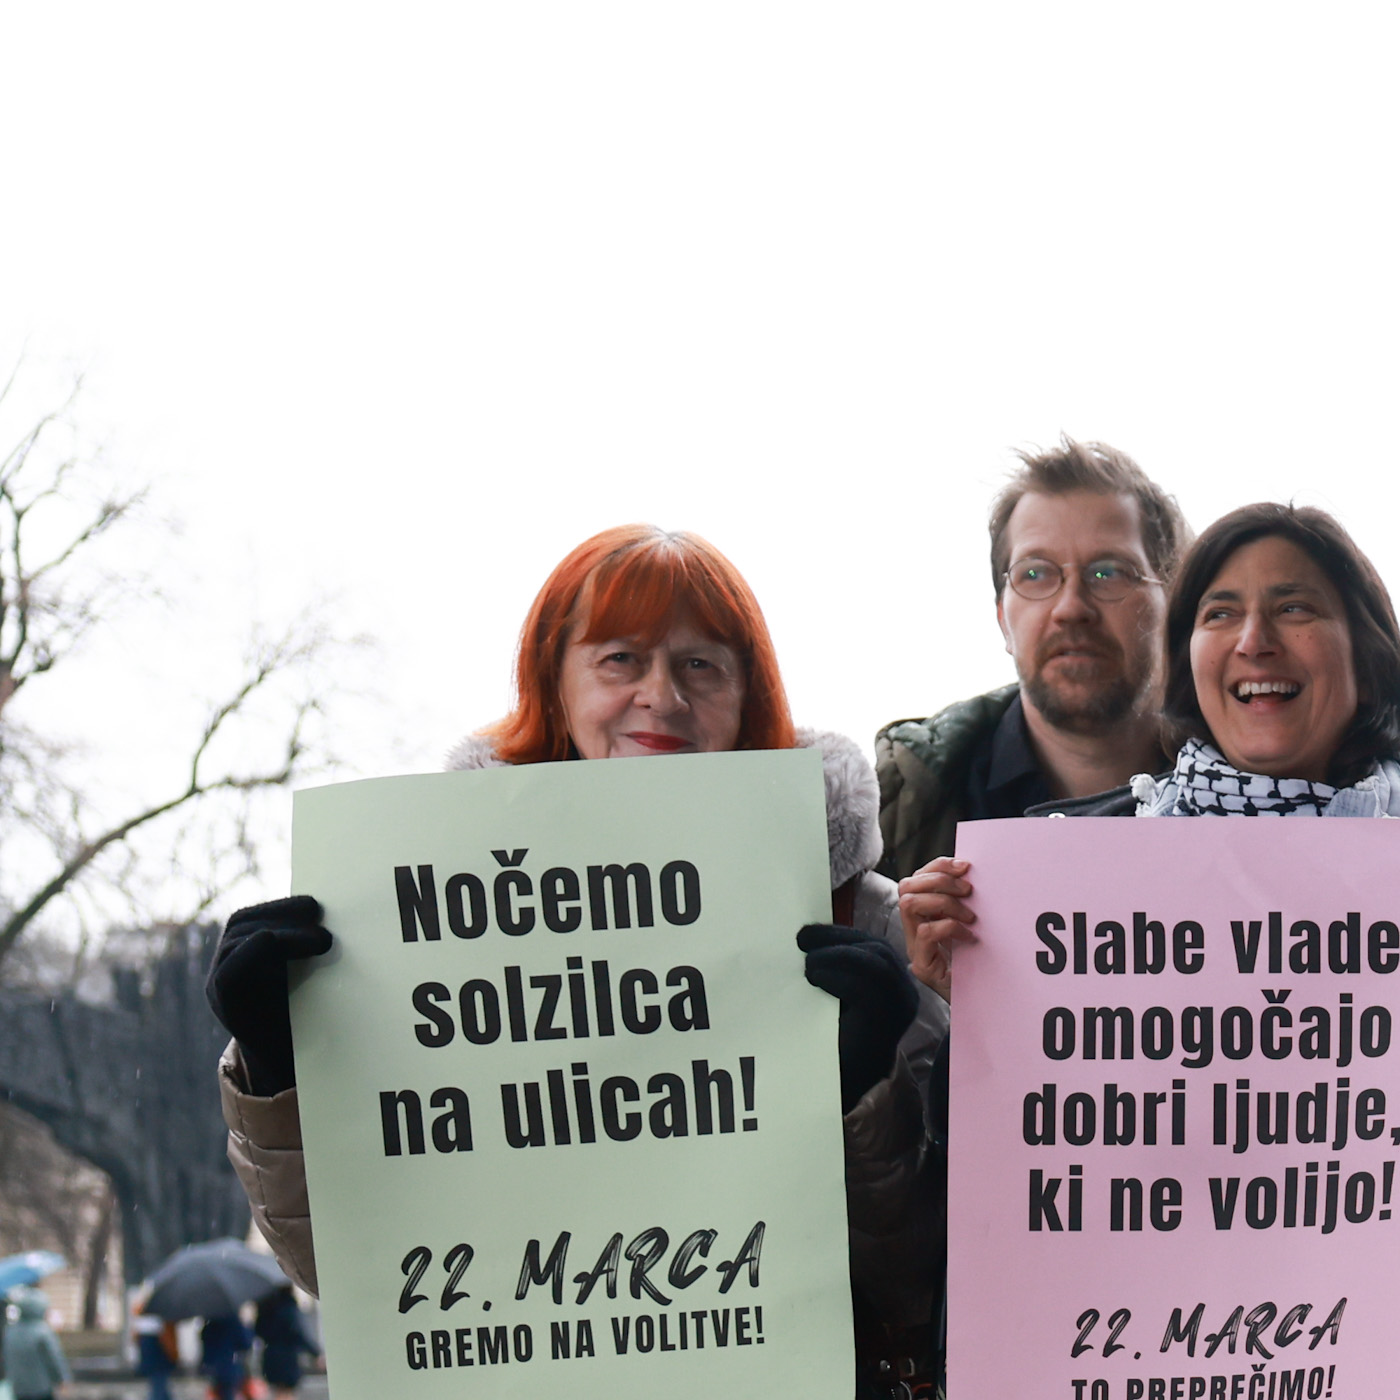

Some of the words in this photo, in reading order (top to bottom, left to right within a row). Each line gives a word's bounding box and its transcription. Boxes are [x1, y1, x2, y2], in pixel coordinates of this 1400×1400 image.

[394, 848, 701, 943] Nočemo
[1036, 912, 1204, 975] Slabe
[1230, 912, 1399, 974] vlade
[412, 956, 710, 1048] solzilca
[1043, 989, 1391, 1068] omogočajo
[379, 1087, 473, 1156] na
[501, 1056, 758, 1148] ulicah!
[1023, 1079, 1185, 1146] dobri
[1029, 1165, 1082, 1231] ki
[1110, 1178, 1182, 1231] ne
[1208, 1161, 1395, 1234] volijo!
[398, 1243, 492, 1314] 22.
[515, 1221, 766, 1306] MARCA
[406, 1324, 532, 1370] GREMO
[551, 1319, 595, 1360] NA
[611, 1306, 764, 1355] VOLITVE!
[1071, 1308, 1141, 1359] 22.
[1159, 1297, 1347, 1360] MARCA
